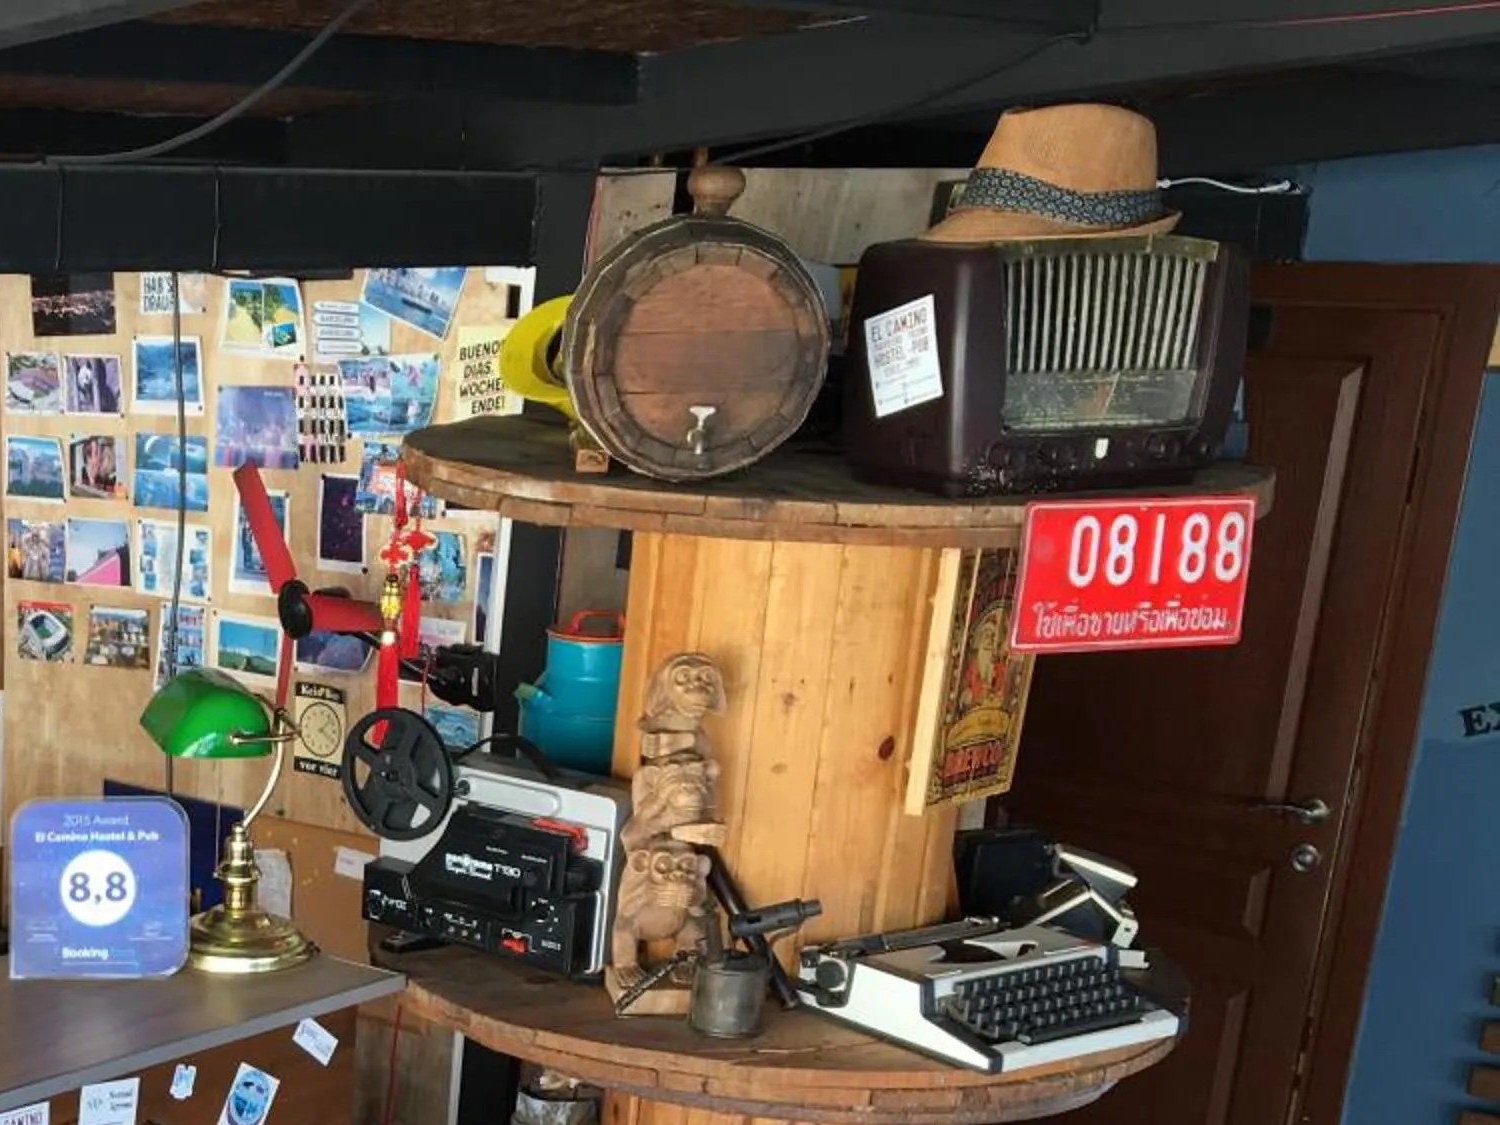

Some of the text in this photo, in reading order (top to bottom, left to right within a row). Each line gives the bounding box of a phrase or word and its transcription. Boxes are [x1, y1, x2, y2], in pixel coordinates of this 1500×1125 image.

[1068, 511, 1246, 587] 08188
[47, 831, 88, 842] Camino
[90, 831, 126, 842] Hostel
[138, 831, 160, 841] Pub
[69, 872, 128, 905] 8,8
